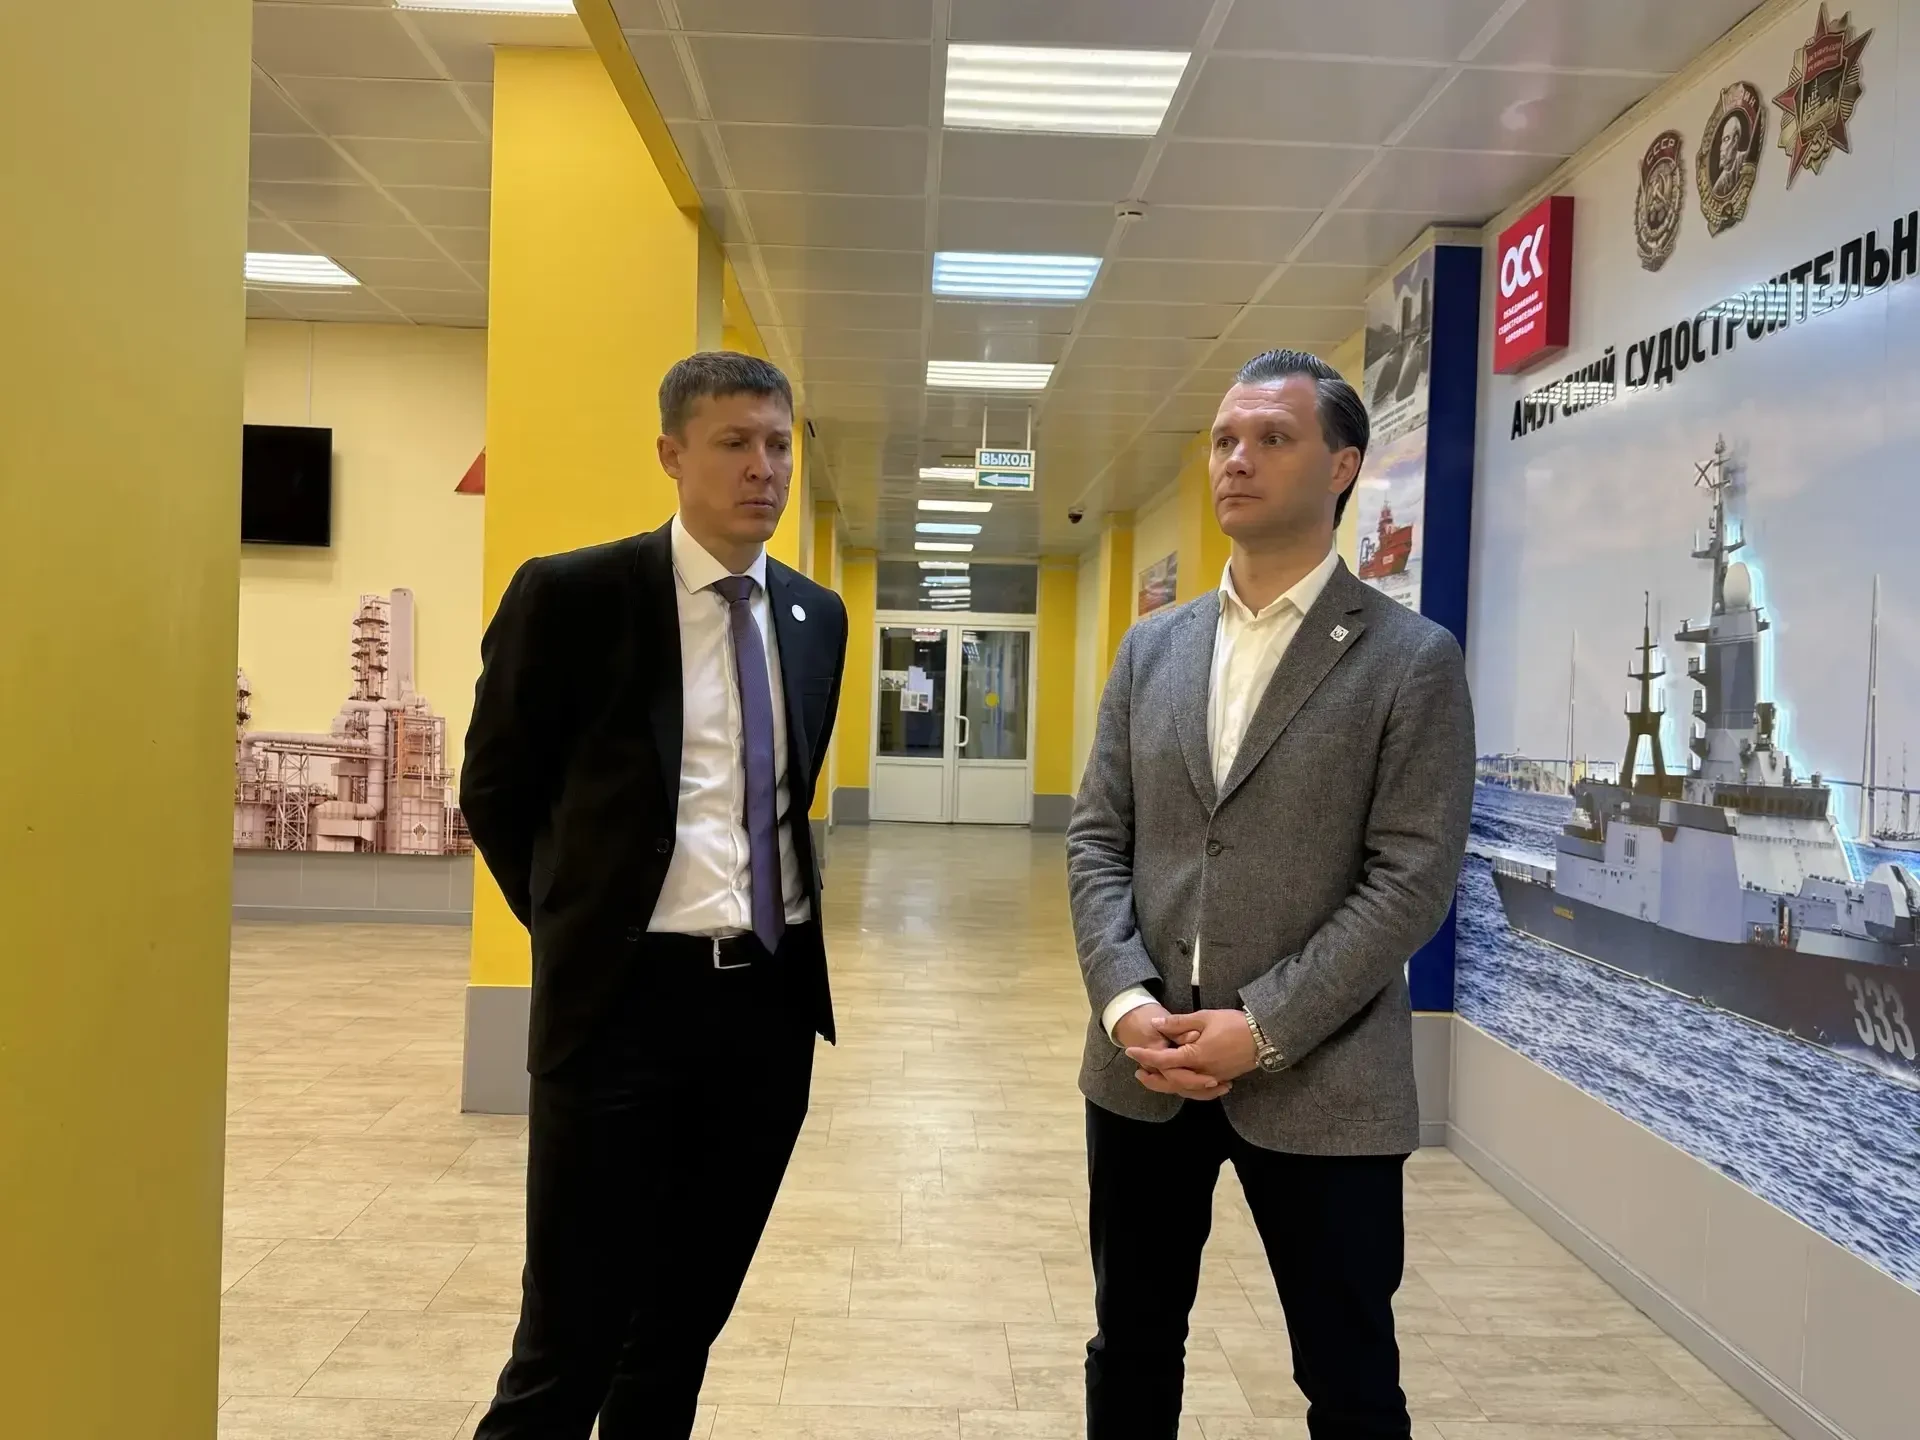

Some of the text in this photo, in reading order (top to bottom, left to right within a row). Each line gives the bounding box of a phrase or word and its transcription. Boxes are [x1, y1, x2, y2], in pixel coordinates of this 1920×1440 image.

[1646, 138, 1676, 165] СССР
[1500, 224, 1545, 298] ОСК
[1510, 210, 1919, 441] АМУРСКИЙ СУДОСТРОИТЕЛЬН
[981, 452, 1030, 467] ВЫХОД
[1845, 973, 1916, 1061] 333
